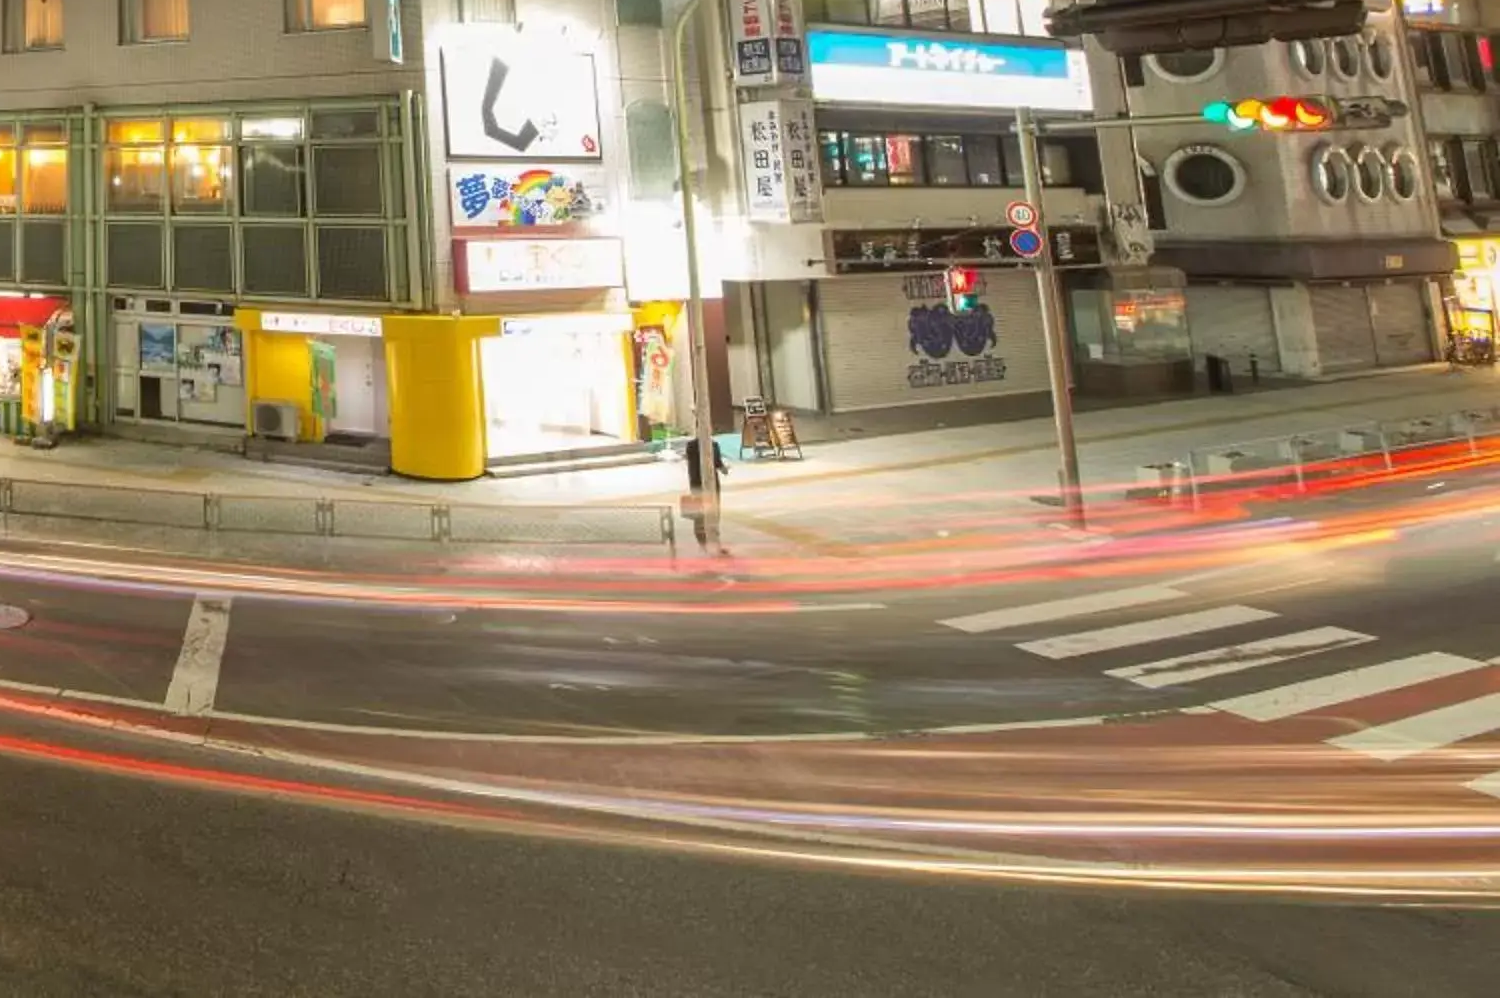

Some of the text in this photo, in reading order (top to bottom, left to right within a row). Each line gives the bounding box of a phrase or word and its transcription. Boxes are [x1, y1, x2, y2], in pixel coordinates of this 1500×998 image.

[455, 172, 491, 220] 夢
[752, 120, 773, 197] 松田屋
[787, 120, 808, 197] 松田屋
